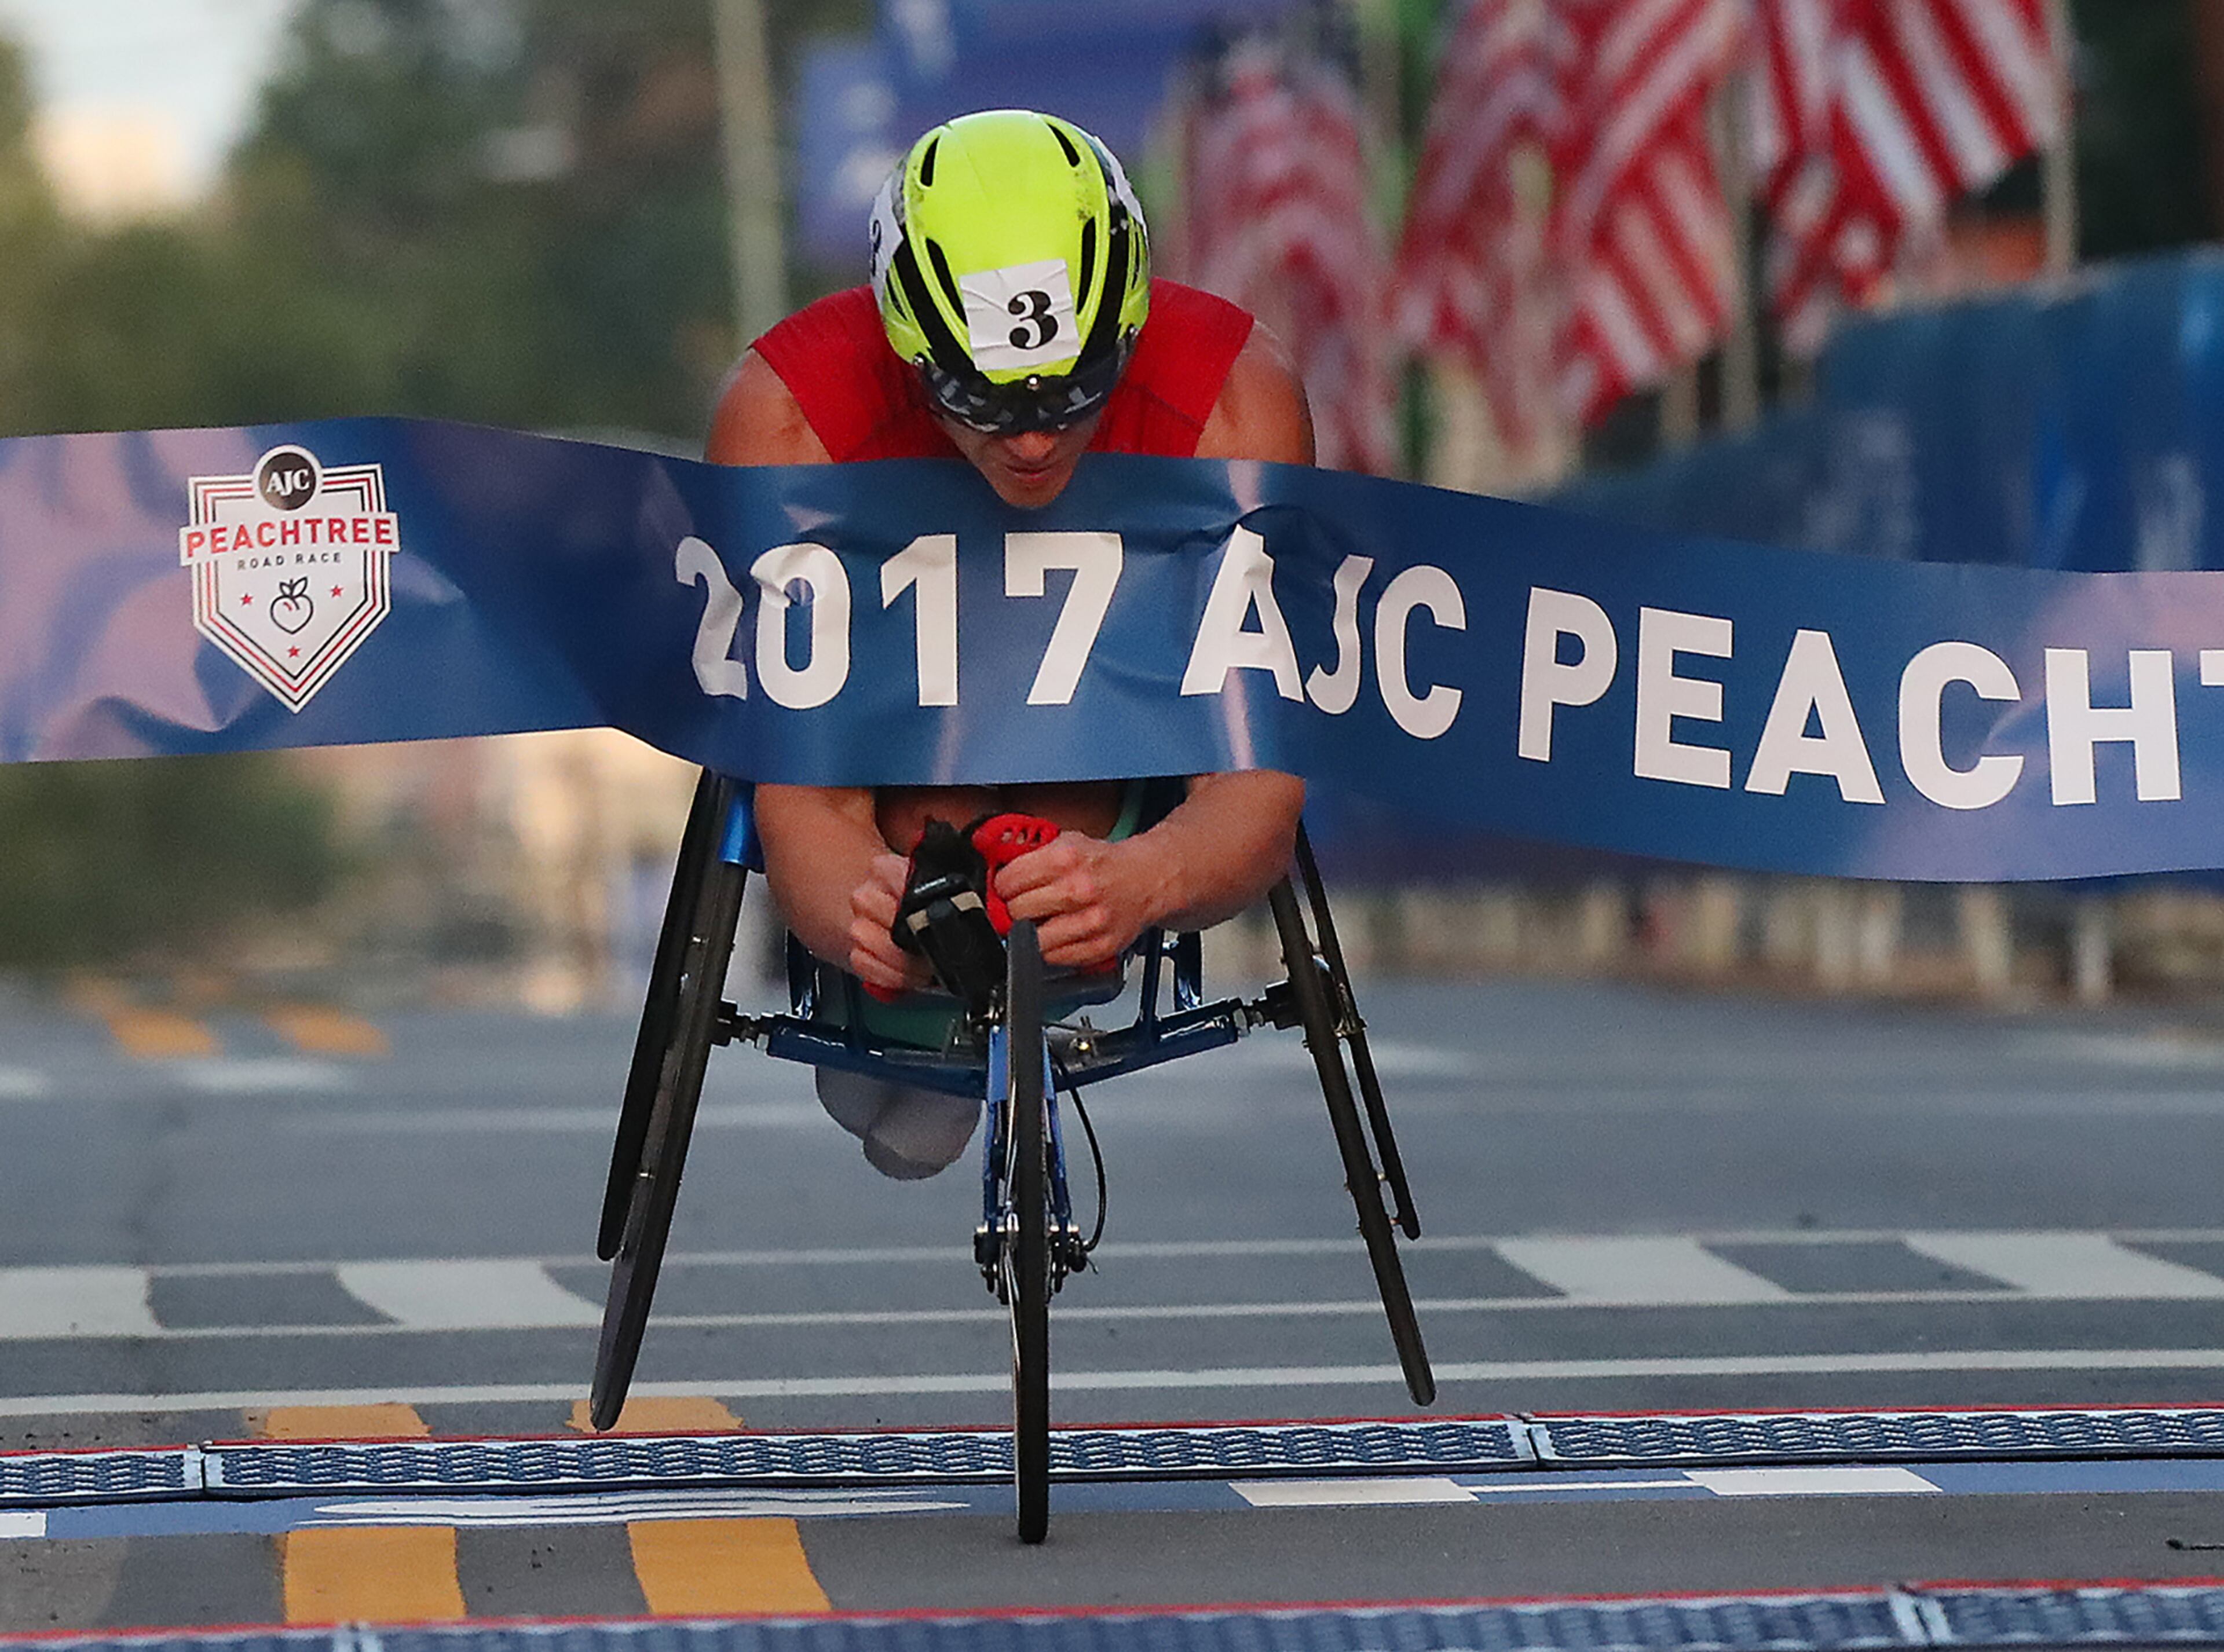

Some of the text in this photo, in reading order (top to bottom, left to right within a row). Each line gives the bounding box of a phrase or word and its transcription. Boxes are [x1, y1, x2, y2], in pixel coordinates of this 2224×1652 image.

[1007, 290, 1059, 350] 3
[265, 468, 311, 496] AJC
[186, 517, 393, 558] PEACHTREE
[237, 552, 341, 570] ROAD RACE
[675, 532, 1124, 710] 2017
[1180, 523, 1467, 739] AJC
